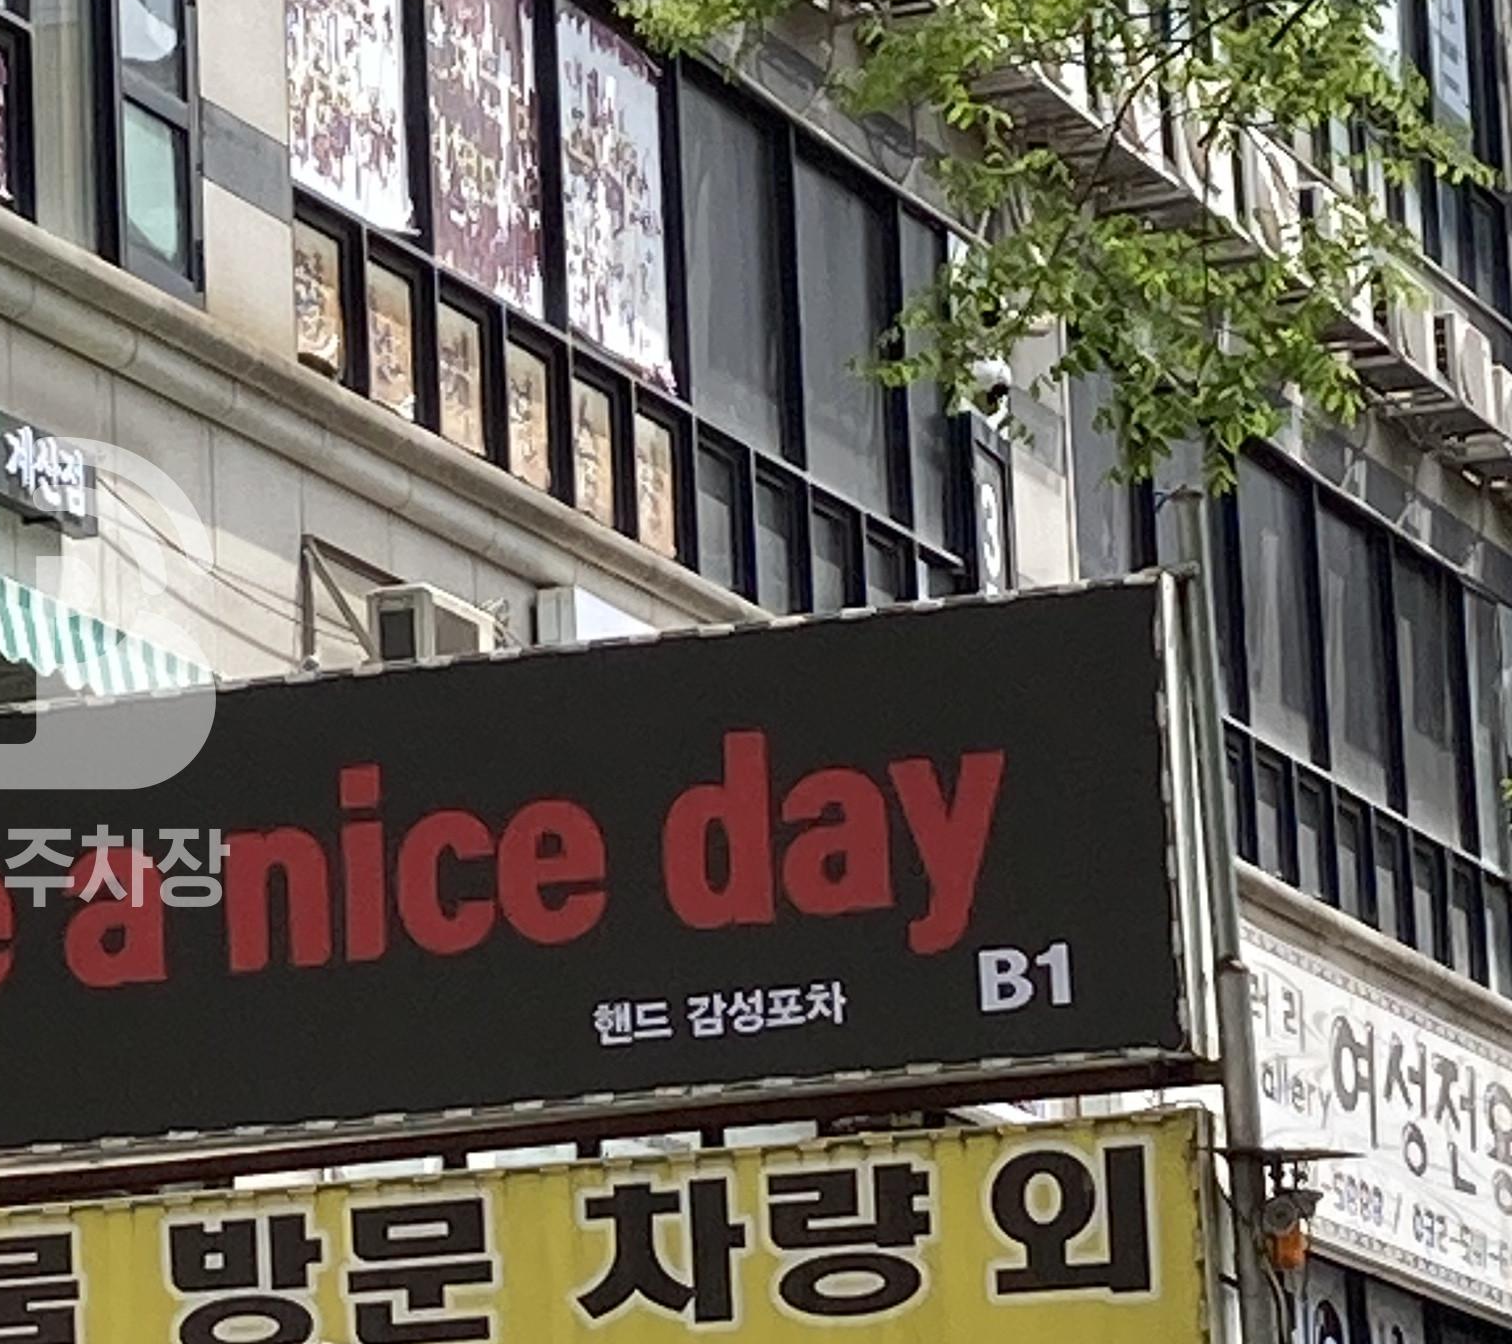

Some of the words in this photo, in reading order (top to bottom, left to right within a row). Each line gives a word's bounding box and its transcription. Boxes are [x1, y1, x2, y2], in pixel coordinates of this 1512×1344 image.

[63, 845, 167, 989] a
[226, 763, 608, 974] nice
[661, 731, 1006, 954] day
[593, 996, 673, 1047] 핸드
[686, 981, 848, 1038] 감성포차
[977, 942, 1073, 1013] B1
[1250, 972, 1306, 1052] 러리
[1262, 1056, 1332, 1130] allery
[577, 1161, 931, 1324] 차량
[989, 1143, 1152, 1296] 외
